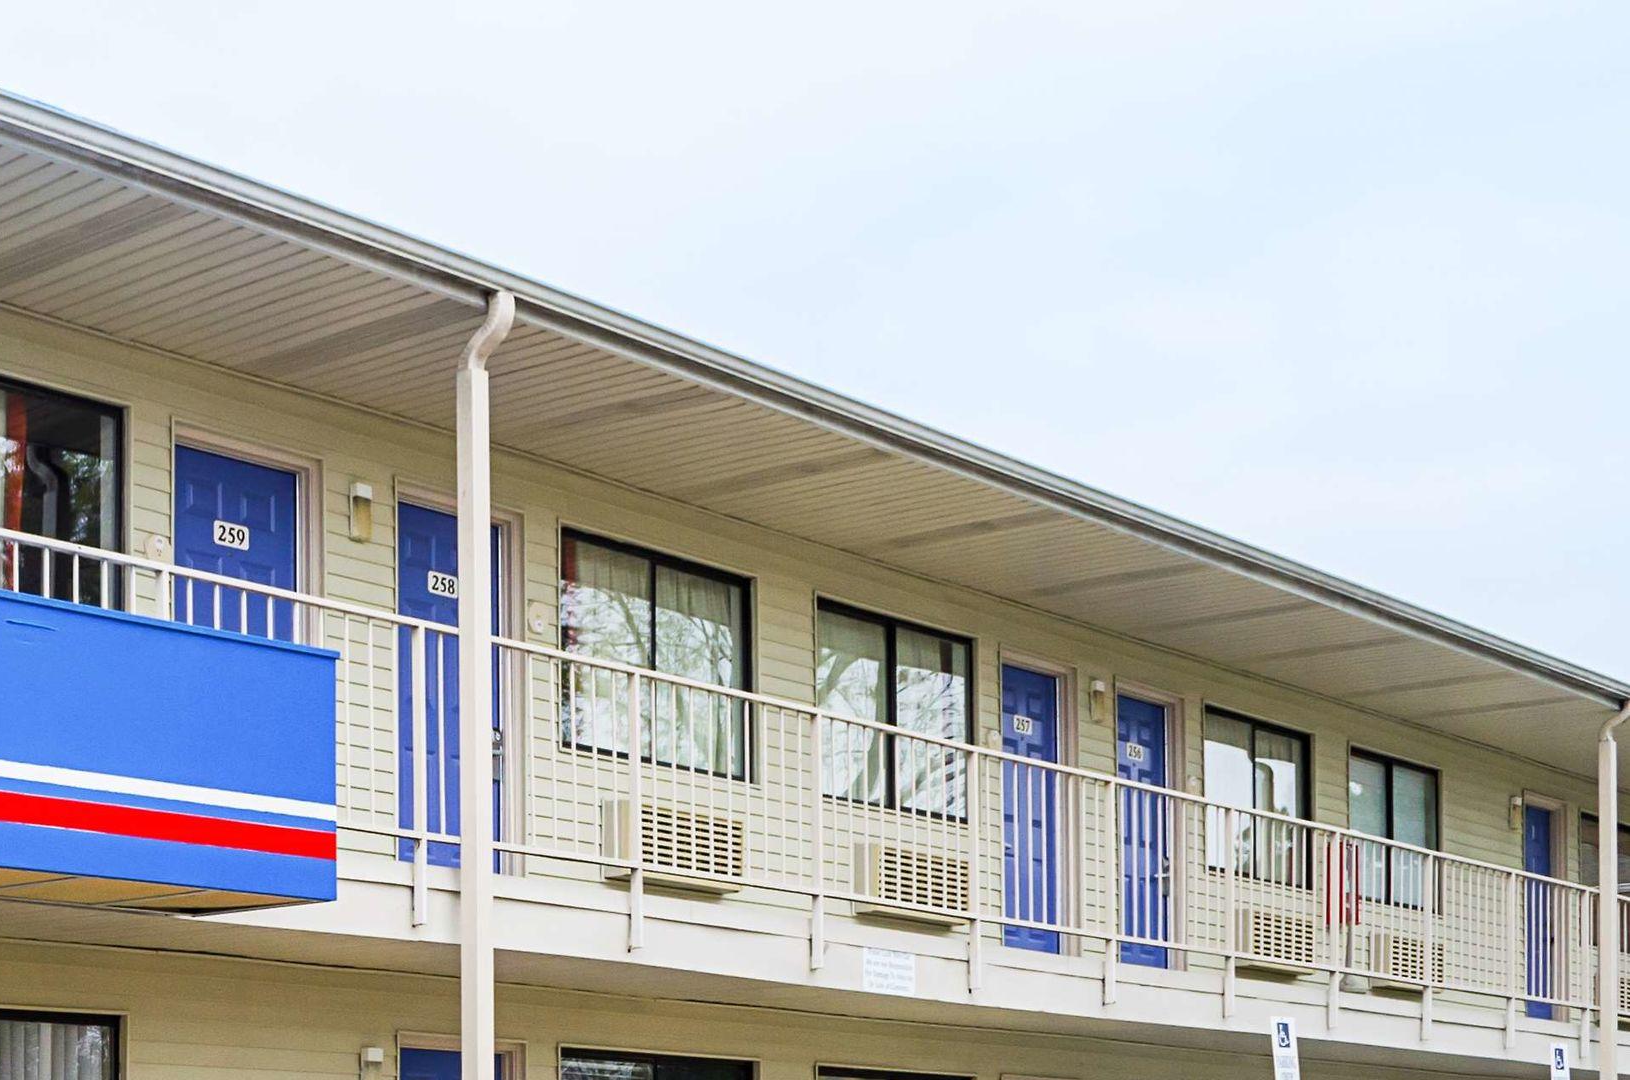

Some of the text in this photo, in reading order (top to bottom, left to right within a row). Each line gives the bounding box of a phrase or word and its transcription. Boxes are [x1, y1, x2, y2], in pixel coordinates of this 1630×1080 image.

[217, 524, 246, 546] 259
[431, 575, 456, 595] 258
[1015, 717, 1031, 732] 257
